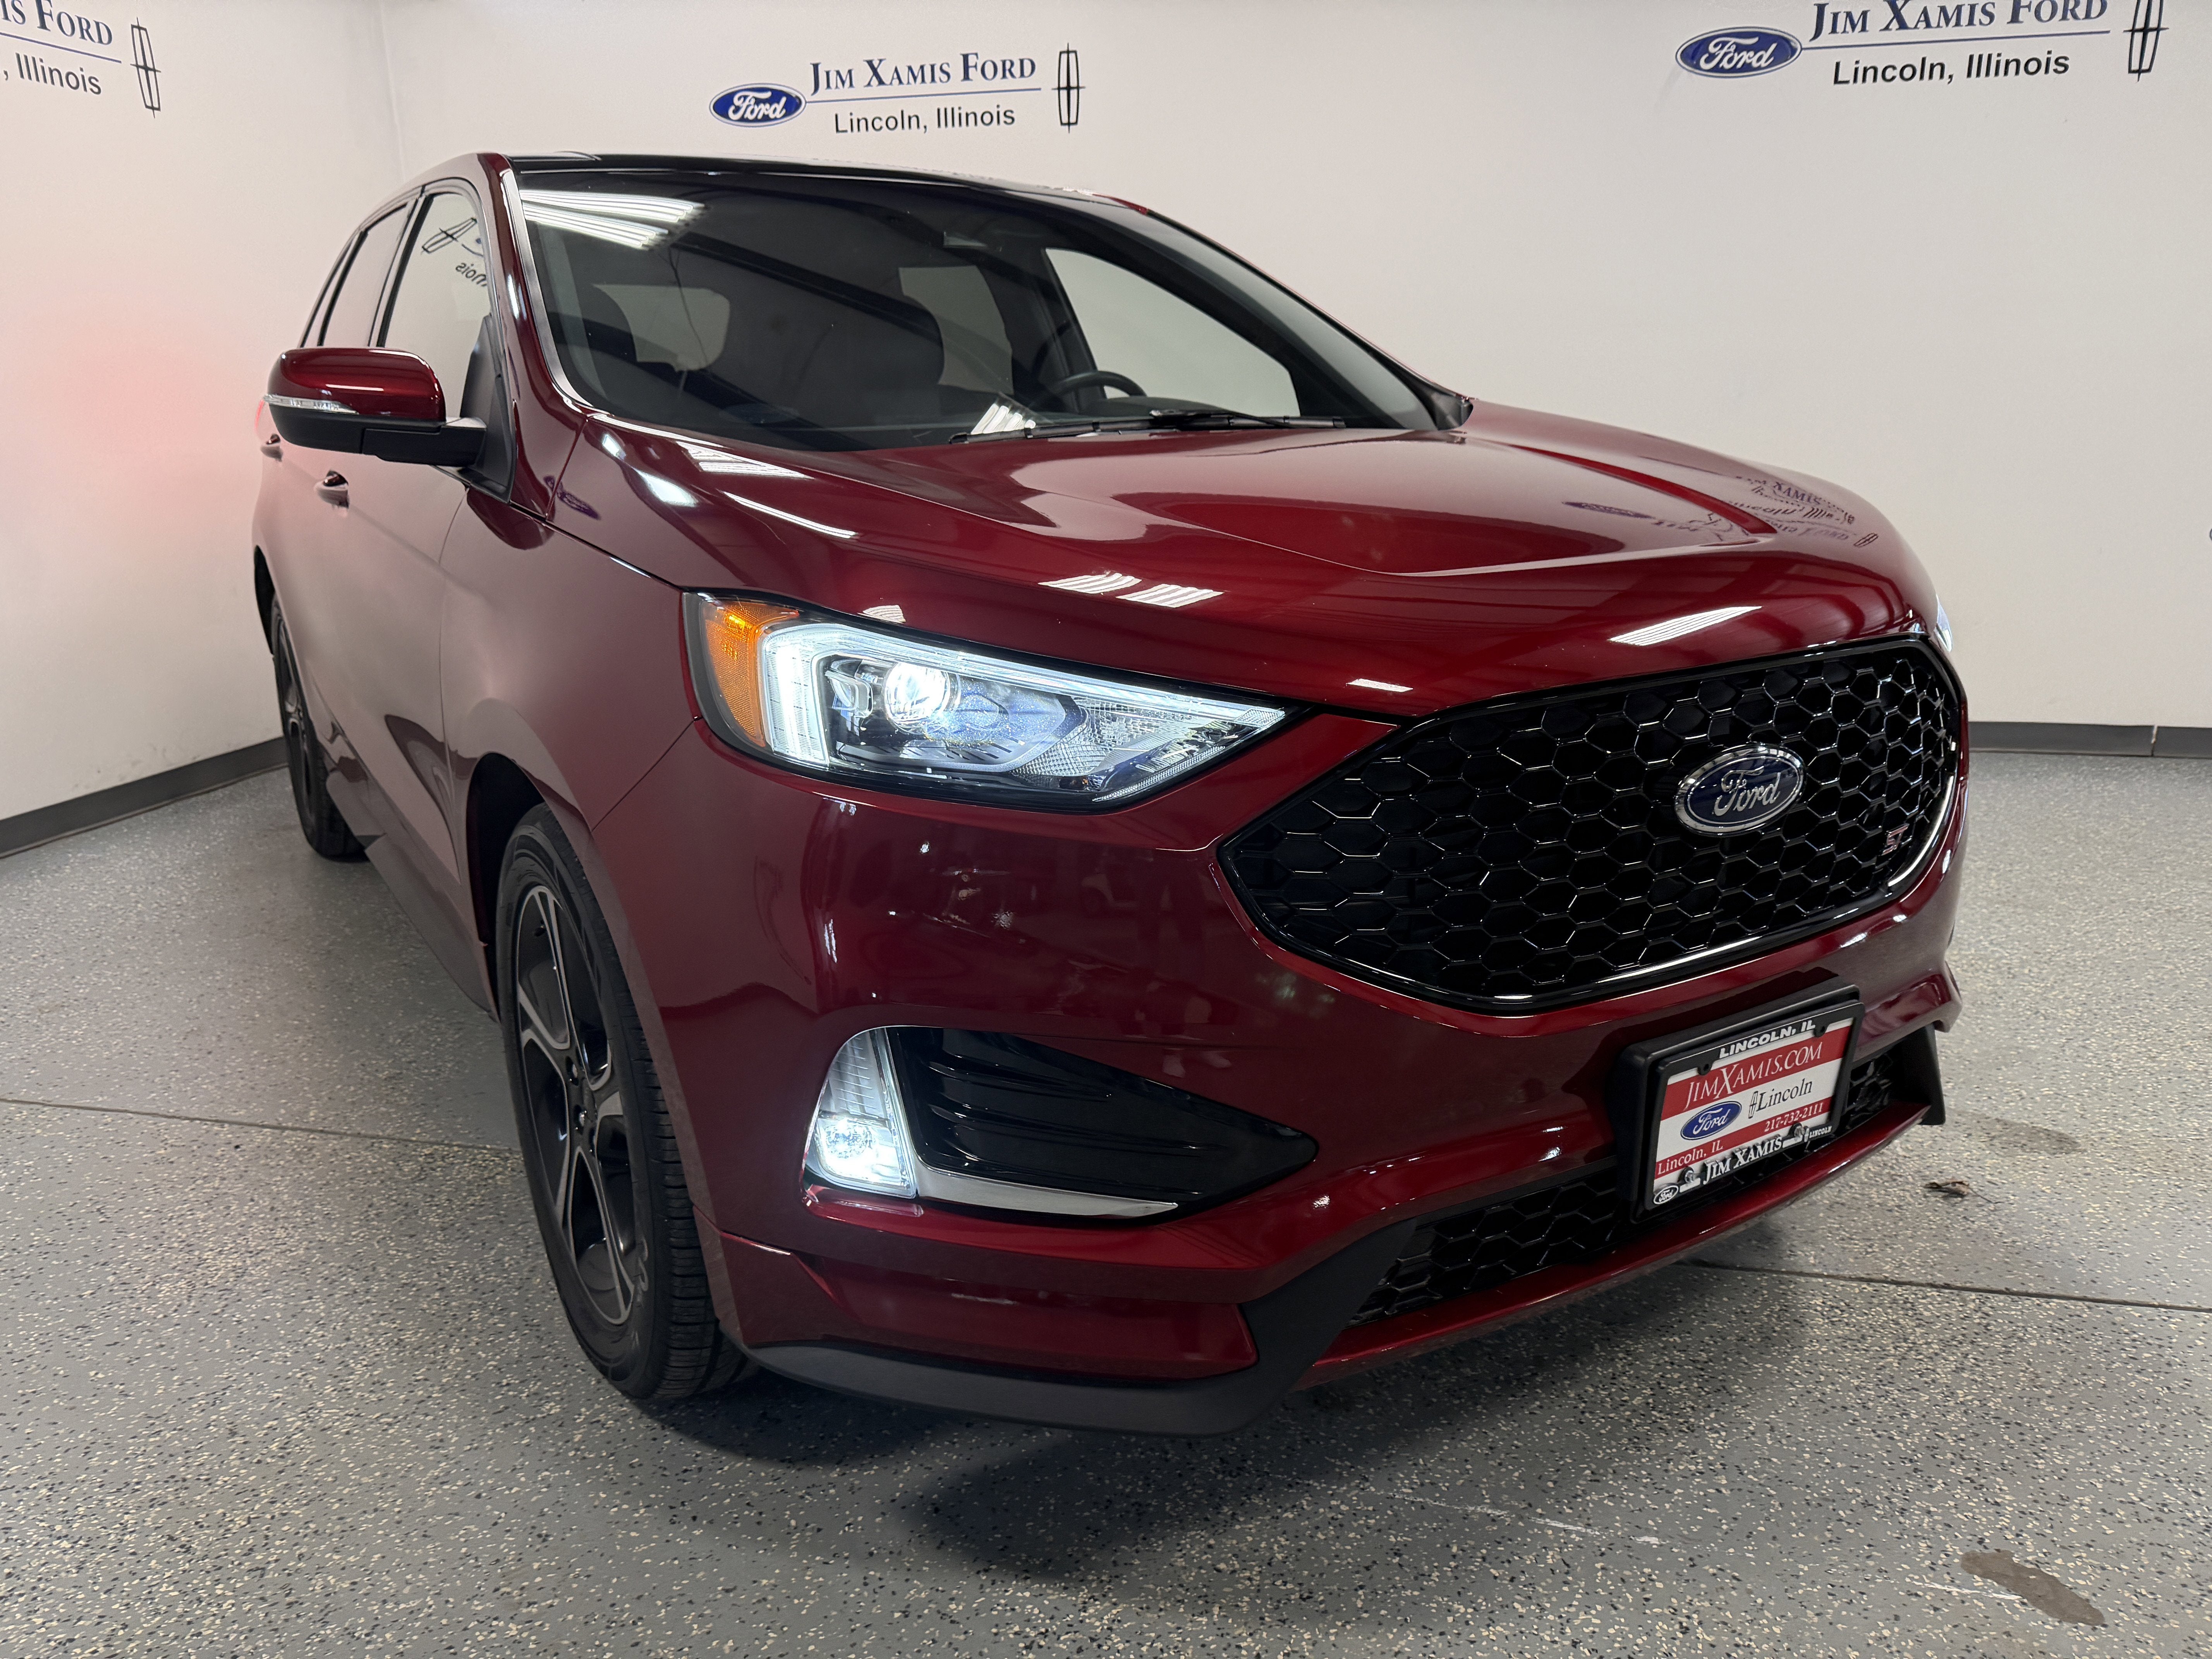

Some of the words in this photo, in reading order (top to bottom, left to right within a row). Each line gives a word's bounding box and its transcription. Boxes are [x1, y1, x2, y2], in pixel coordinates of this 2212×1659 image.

[36, 0, 113, 45] FORD
[1809, 2, 1871, 41] JIM
[1879, 0, 1996, 31] XAMIS
[2006, 0, 2107, 24] FORD
[1700, 37, 1775, 69] Ford
[1833, 56, 1954, 86] Lincoln,
[1966, 50, 2069, 78] Illinois
[15, 52, 101, 95] Illinois
[810, 62, 854, 96] JIM
[863, 58, 951, 88] XAMIS
[960, 52, 1036, 81] FORD
[728, 90, 786, 120] Ford
[834, 110, 928, 134] Lincoln,
[936, 105, 1015, 129] Illinois
[1712, 765, 1781, 816] Ford
[1719, 1026, 1796, 1059] LINCOLN,
[1800, 1020, 1815, 1033] IL
[1683, 1042, 1822, 1112] JIMXAMIS.COM
[1755, 1078, 1813, 1111] Lincoln
[1692, 1107, 1729, 1135] Ford
[1764, 1103, 1824, 1132] 217-732-2111
[1657, 1149, 1706, 1175] Lincoln,
[1712, 1140, 1723, 1152] IL
[1702, 1158, 1731, 1185] JIM
[1733, 1139, 1783, 1168] XAMIS
